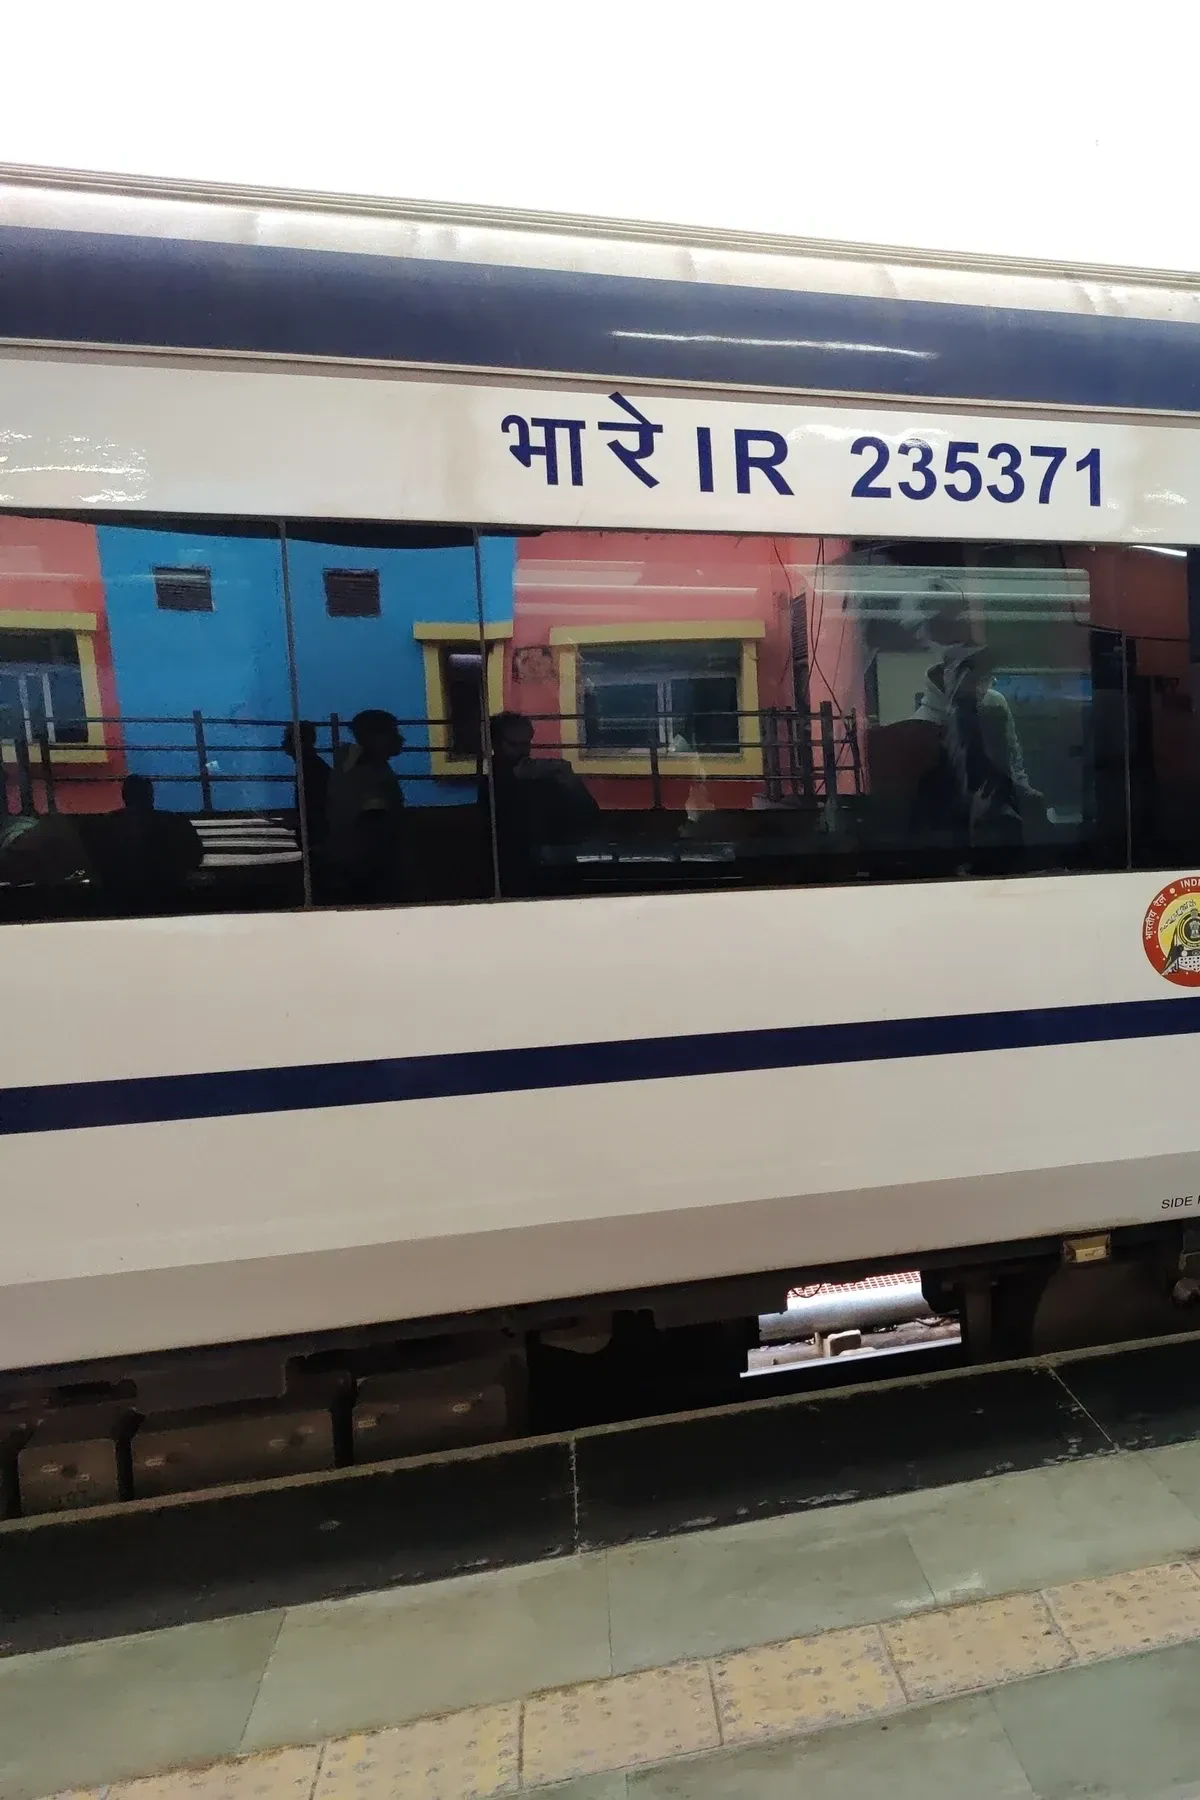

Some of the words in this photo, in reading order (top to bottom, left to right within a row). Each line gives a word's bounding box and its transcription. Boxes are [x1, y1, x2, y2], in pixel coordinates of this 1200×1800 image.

[697, 427, 795, 497] IR
[850, 436, 1103, 507] 235371
[1145, 909, 1157, 940] भारतीय
[1153, 893, 1167, 907] रेल
[1161, 1195, 1193, 1209] SIDE
